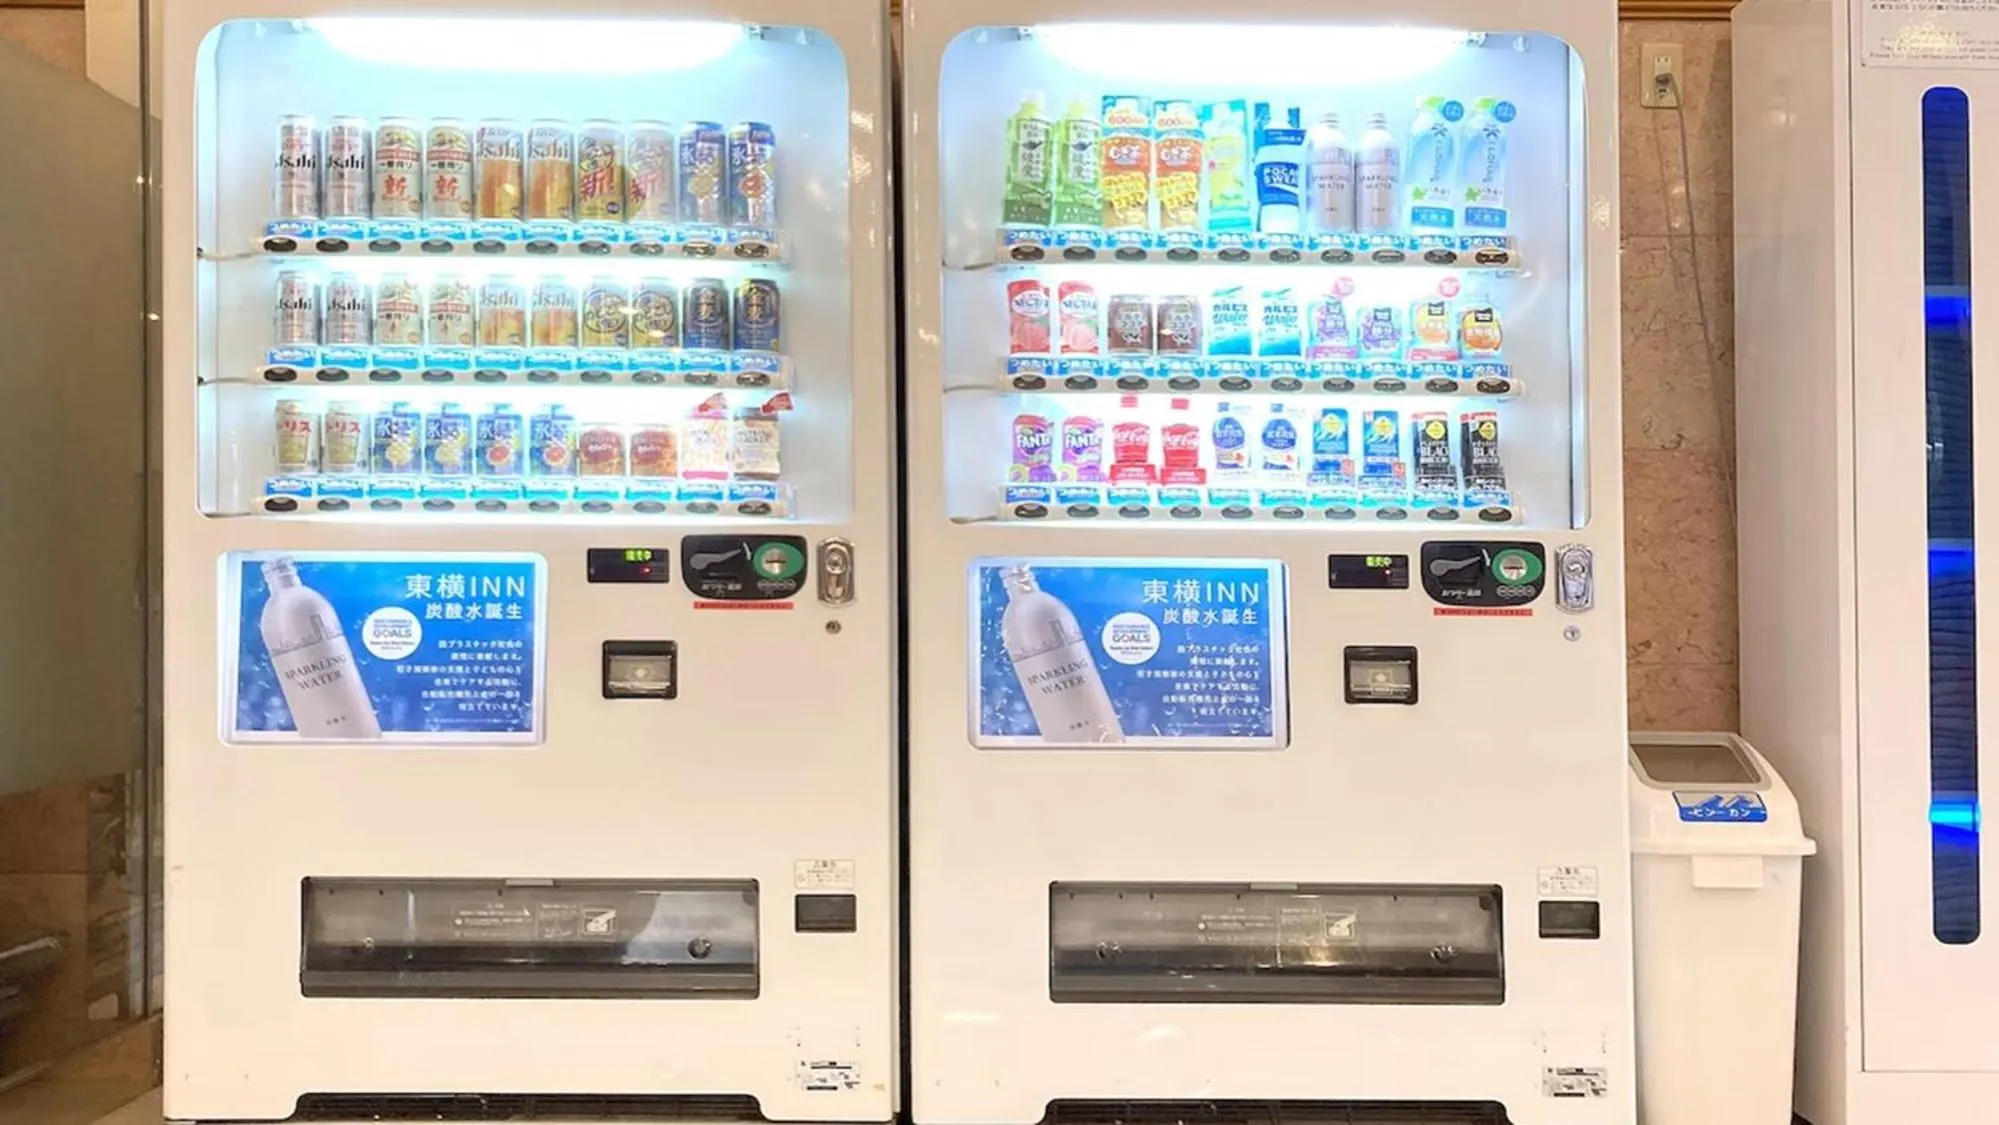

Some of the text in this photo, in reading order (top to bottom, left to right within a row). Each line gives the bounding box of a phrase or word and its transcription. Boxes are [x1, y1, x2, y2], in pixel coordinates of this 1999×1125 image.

[405, 573, 525, 599] 東横INN
[1142, 579, 1259, 604] 東横INN
[425, 602, 523, 619] 炭酸水誕生
[1163, 608, 1258, 625] 炭酸水誕生
[284, 654, 347, 681] SPARKLING
[1028, 659, 1088, 686] SPARKLING
[299, 670, 343, 690] WATER
[1041, 676, 1086, 694] WATER
